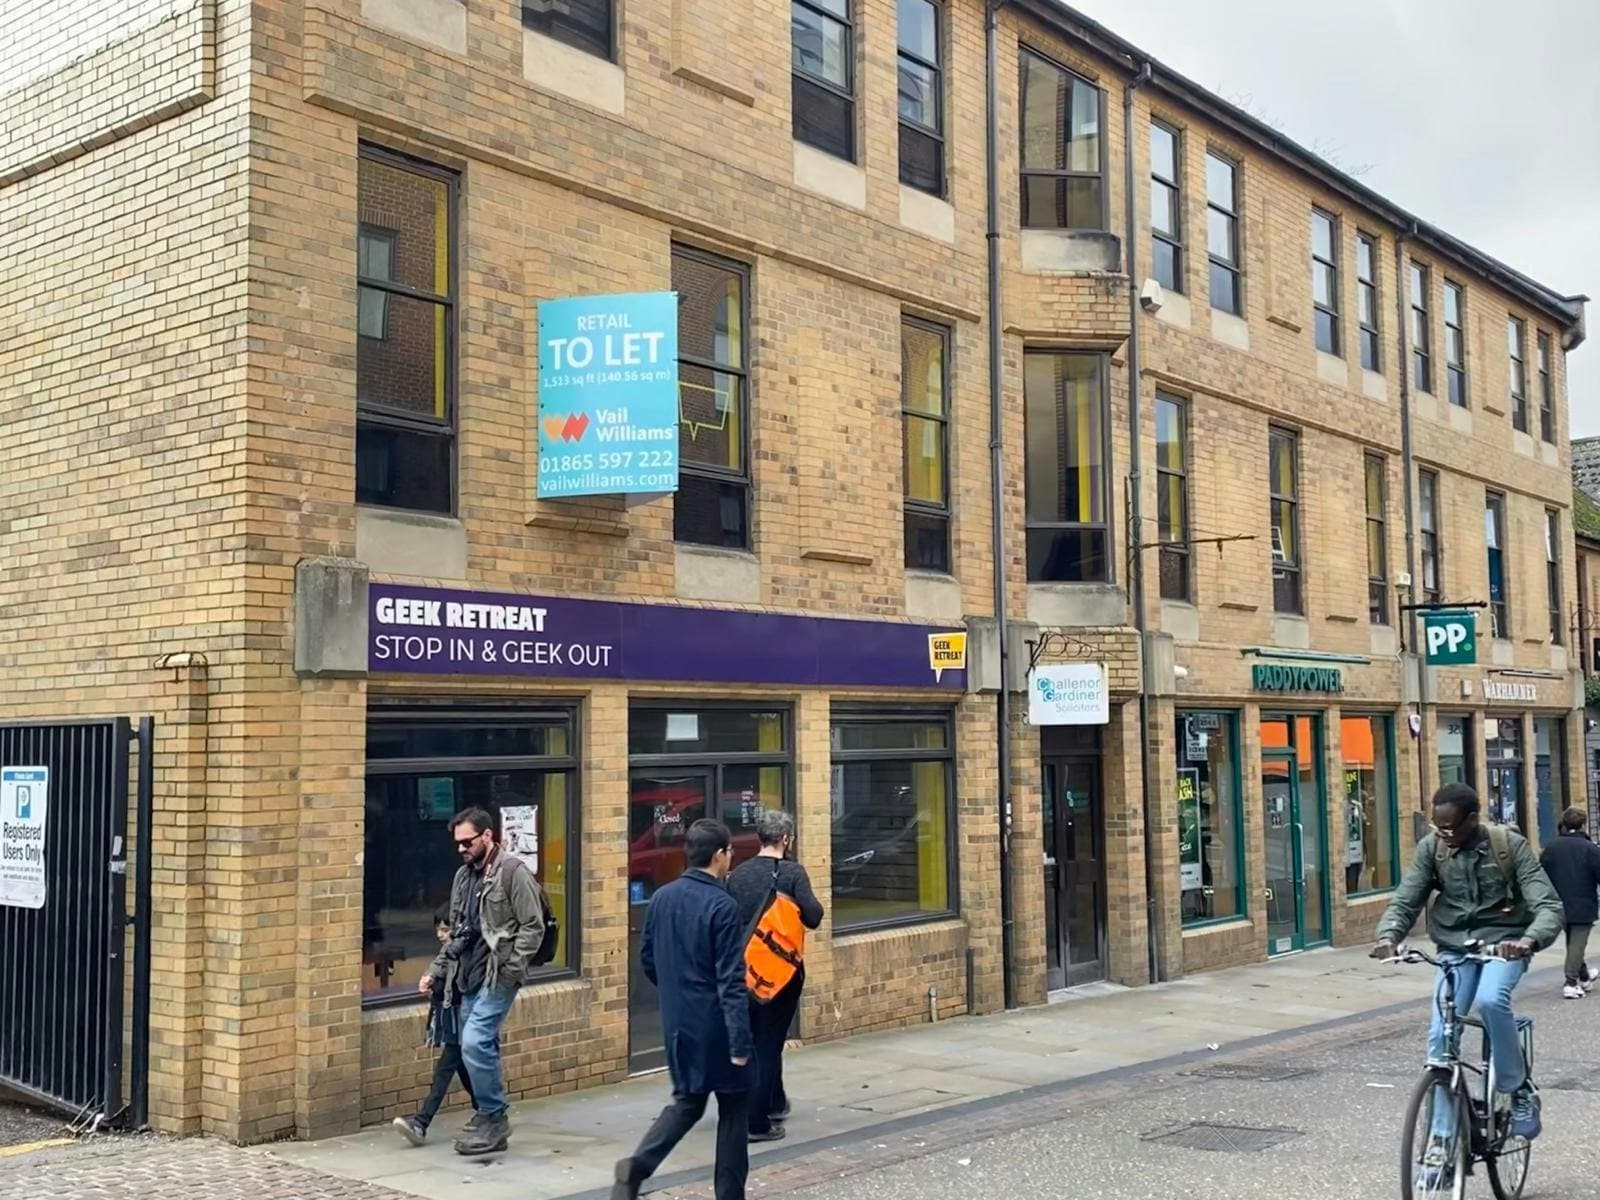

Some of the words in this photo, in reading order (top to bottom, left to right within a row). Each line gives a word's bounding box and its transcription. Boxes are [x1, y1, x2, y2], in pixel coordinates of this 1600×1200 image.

[577, 313, 632, 331] RETAIL
[548, 337, 593, 370] TO
[605, 332, 664, 366] LET
[572, 376, 584, 387] sq
[586, 374, 595, 384] ft
[640, 371, 653, 384] sq
[655, 369, 671, 381] m)
[596, 407, 628, 424] Vail
[596, 425, 673, 442] Williams
[540, 455, 592, 473] 01865
[599, 452, 632, 469] 597
[639, 450, 673, 467] 222
[541, 472, 673, 491] vailwilliams.com
[376, 597, 442, 627] GEEK
[446, 603, 547, 632] RETREAT
[374, 635, 442, 661] STOP
[450, 639, 474, 661] IN
[482, 640, 497, 662] &
[502, 640, 563, 665] GEEK
[568, 643, 612, 667] OUT
[934, 640, 950, 650] GEEK
[934, 651, 962, 660] RETREAT
[3, 822, 42, 843] Registered
[3, 842, 24, 861] Users
[25, 843, 41, 866] Only
